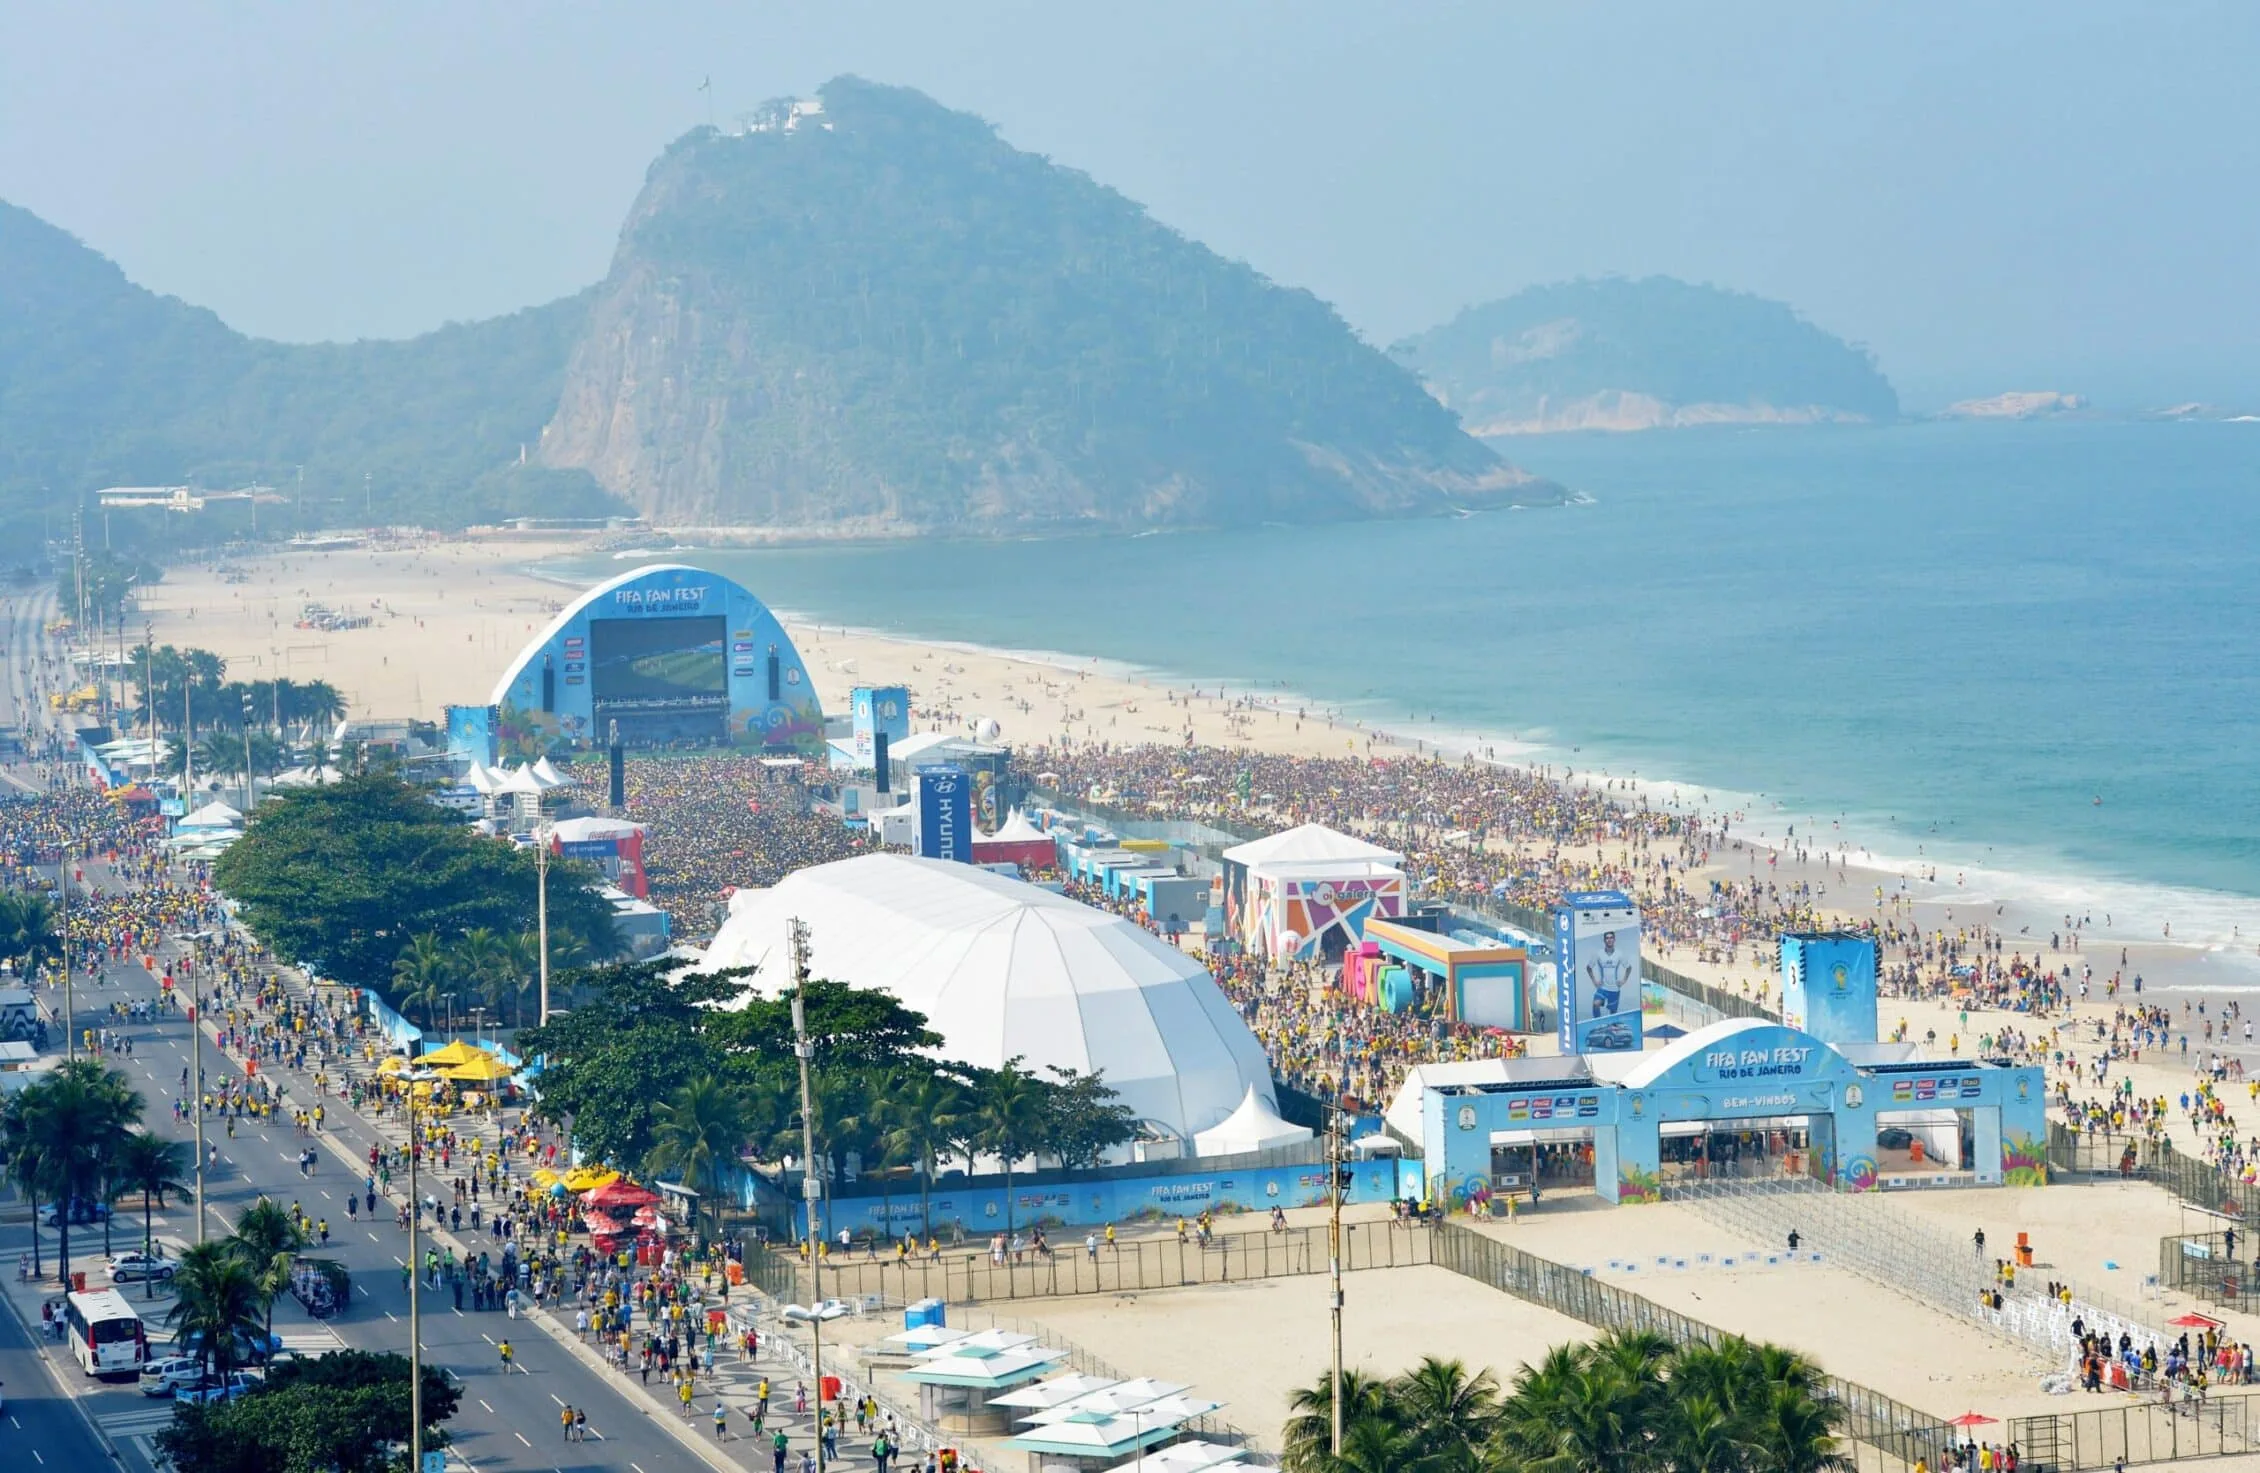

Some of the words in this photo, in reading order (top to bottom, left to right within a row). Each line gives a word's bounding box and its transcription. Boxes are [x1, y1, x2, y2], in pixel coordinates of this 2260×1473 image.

[615, 590, 641, 604] FIFA
[646, 589, 671, 602] FAN
[675, 585, 710, 601] FEST
[1561, 938, 1571, 1049] HYUNDAI
[1706, 1052, 1737, 1068] FIFA
[1741, 1049, 1769, 1065] FAN
[1774, 1047, 1815, 1063] FEST
[1719, 1069, 1737, 1079] RIO
[1740, 1067, 1754, 1077] DE
[1757, 1065, 1801, 1076] JANEIRO
[1723, 1094, 1797, 1108] BEM-VINDOS
[1152, 1186, 1170, 1197] FIFA
[1172, 1184, 1189, 1195] FAN
[1192, 1181, 1216, 1194] FEST
